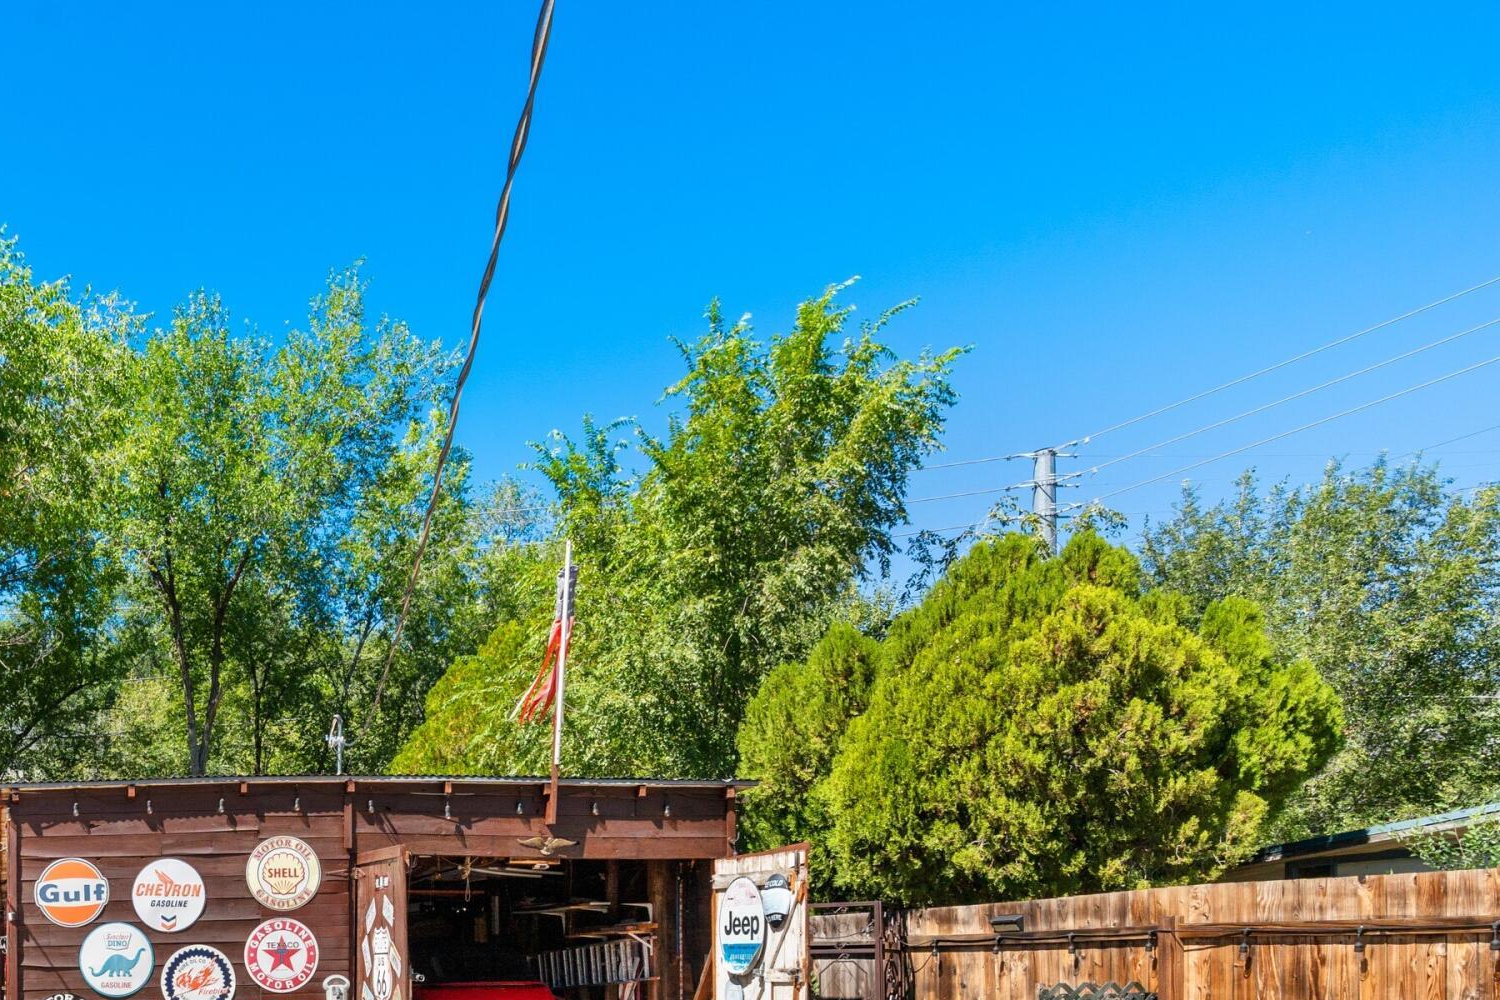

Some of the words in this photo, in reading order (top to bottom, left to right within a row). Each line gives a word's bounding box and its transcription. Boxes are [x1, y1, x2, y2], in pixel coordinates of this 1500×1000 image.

[253, 838, 292, 860] MOTOR
[294, 842, 313, 860] OIL
[267, 867, 300, 878] SHELL
[38, 883, 105, 903] Gulf
[135, 880, 202, 898] CHEVRON
[255, 888, 313, 908] GASOLINE
[150, 899, 188, 908] GASOLINE
[249, 920, 315, 949] GASOLINE
[724, 910, 760, 941] Jeep
[105, 932, 129, 940] Sinclair
[266, 941, 300, 949] TEXACO
[100, 981, 132, 989] GASOLINE
[248, 962, 294, 989] MOTOR
[297, 961, 315, 982] OIL
[376, 969, 387, 996] 66
